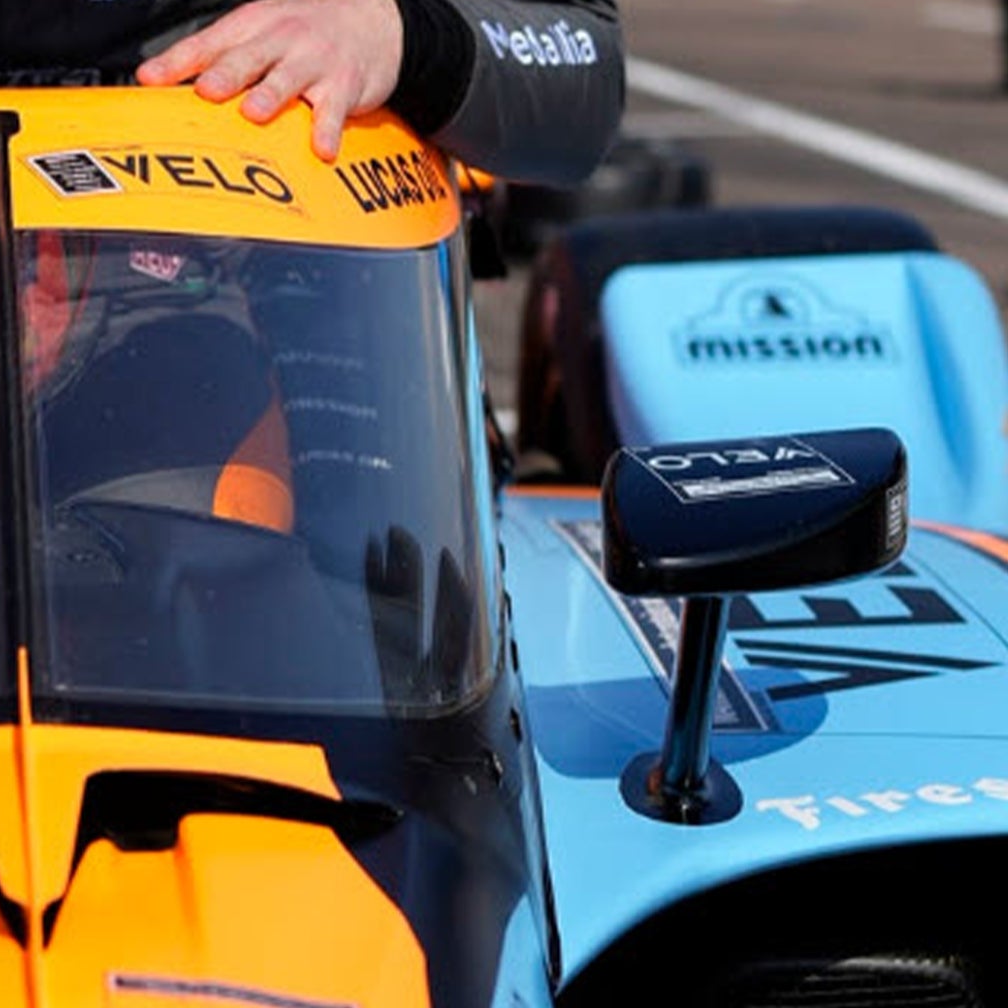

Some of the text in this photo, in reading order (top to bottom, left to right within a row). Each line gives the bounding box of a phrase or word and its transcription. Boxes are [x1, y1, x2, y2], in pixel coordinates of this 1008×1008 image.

[101, 154, 294, 204] VELO
[336, 150, 422, 213] LUCAS
[687, 331, 884, 362] mission
[648, 445, 818, 471] VELO
